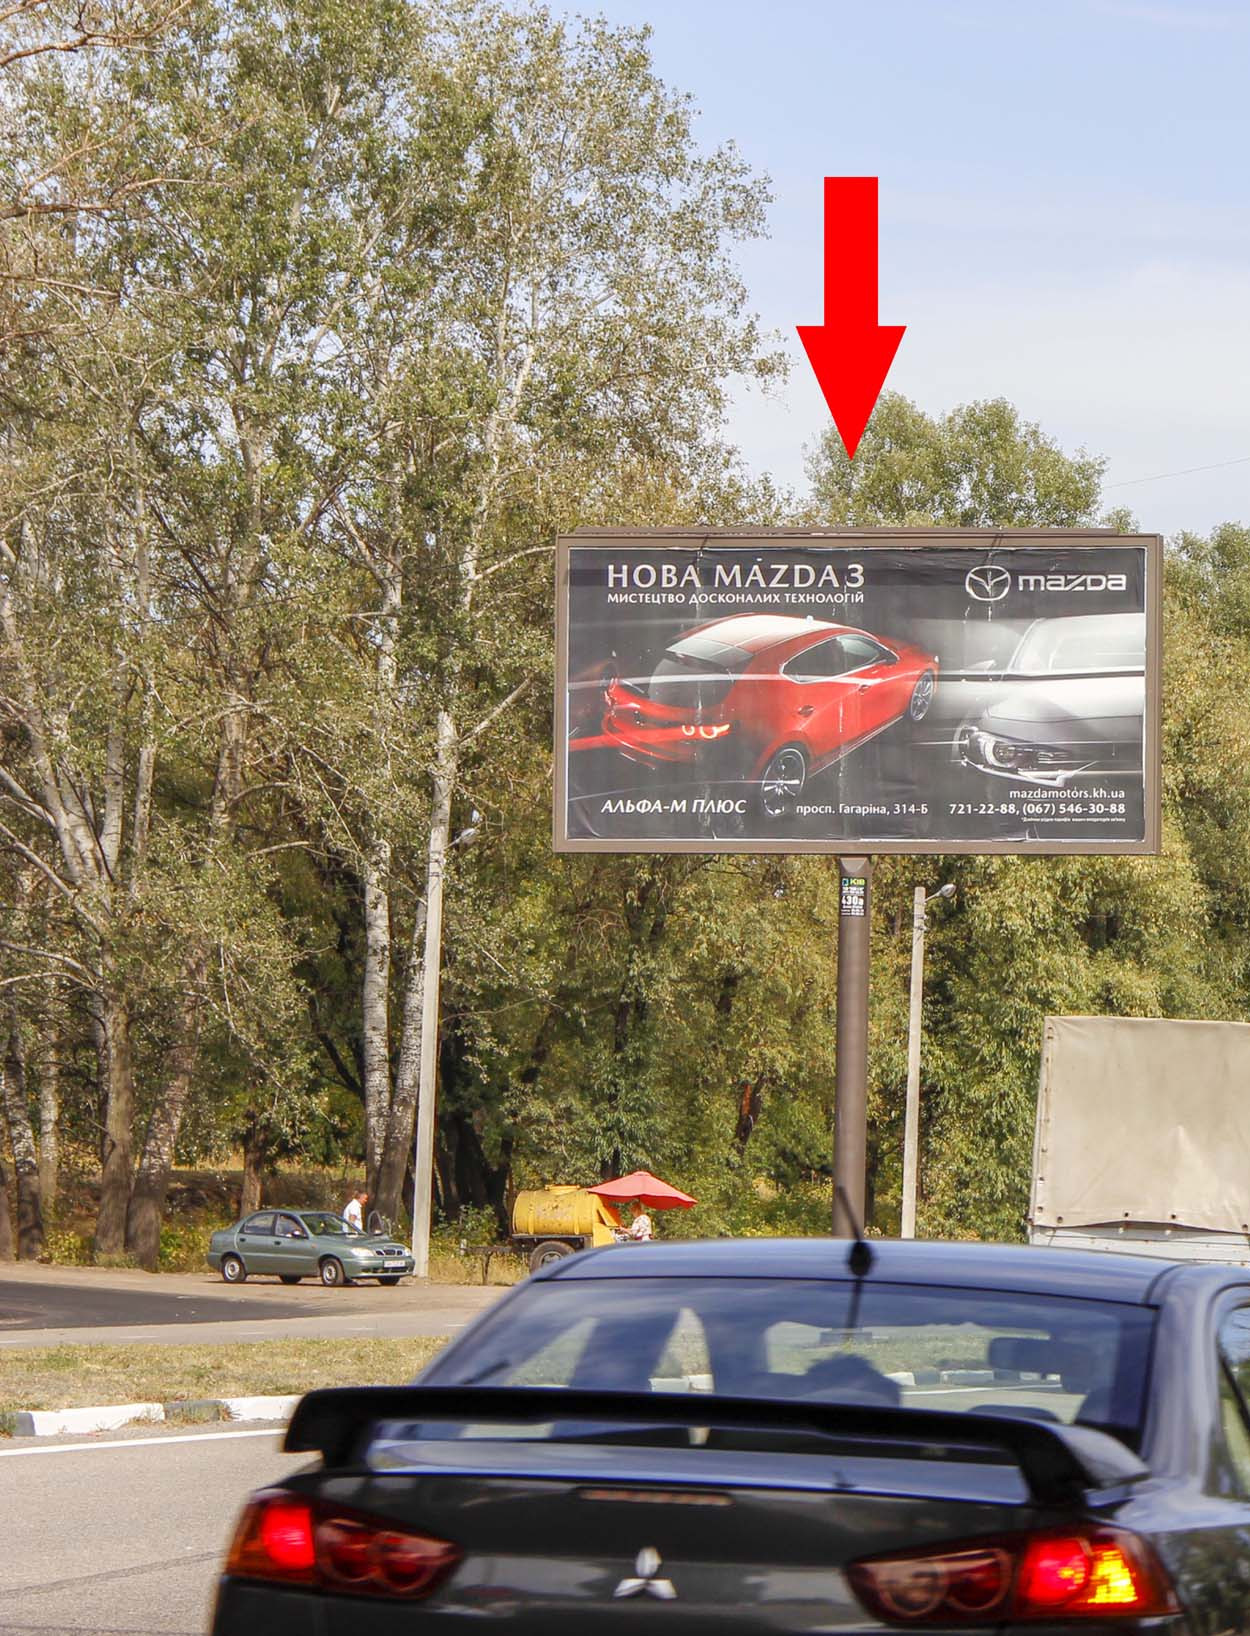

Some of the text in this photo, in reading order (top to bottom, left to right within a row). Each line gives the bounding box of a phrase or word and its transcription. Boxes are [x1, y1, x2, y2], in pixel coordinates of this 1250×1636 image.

[607, 564, 701, 588] НОВА
[607, 590, 864, 605] МИСТЕЦТВО ДОСКОНАЛИХ ТЕХНОЛОГІЙ
[1009, 787, 1126, 799] mazdamotors.kh.ua
[600, 799, 748, 815] АЛЬФА-М ПЛЮС
[796, 803, 929, 816] просп. Гагаріна, 314-Б
[949, 803, 1126, 816] 721-22-88, (067) 546-30-88
